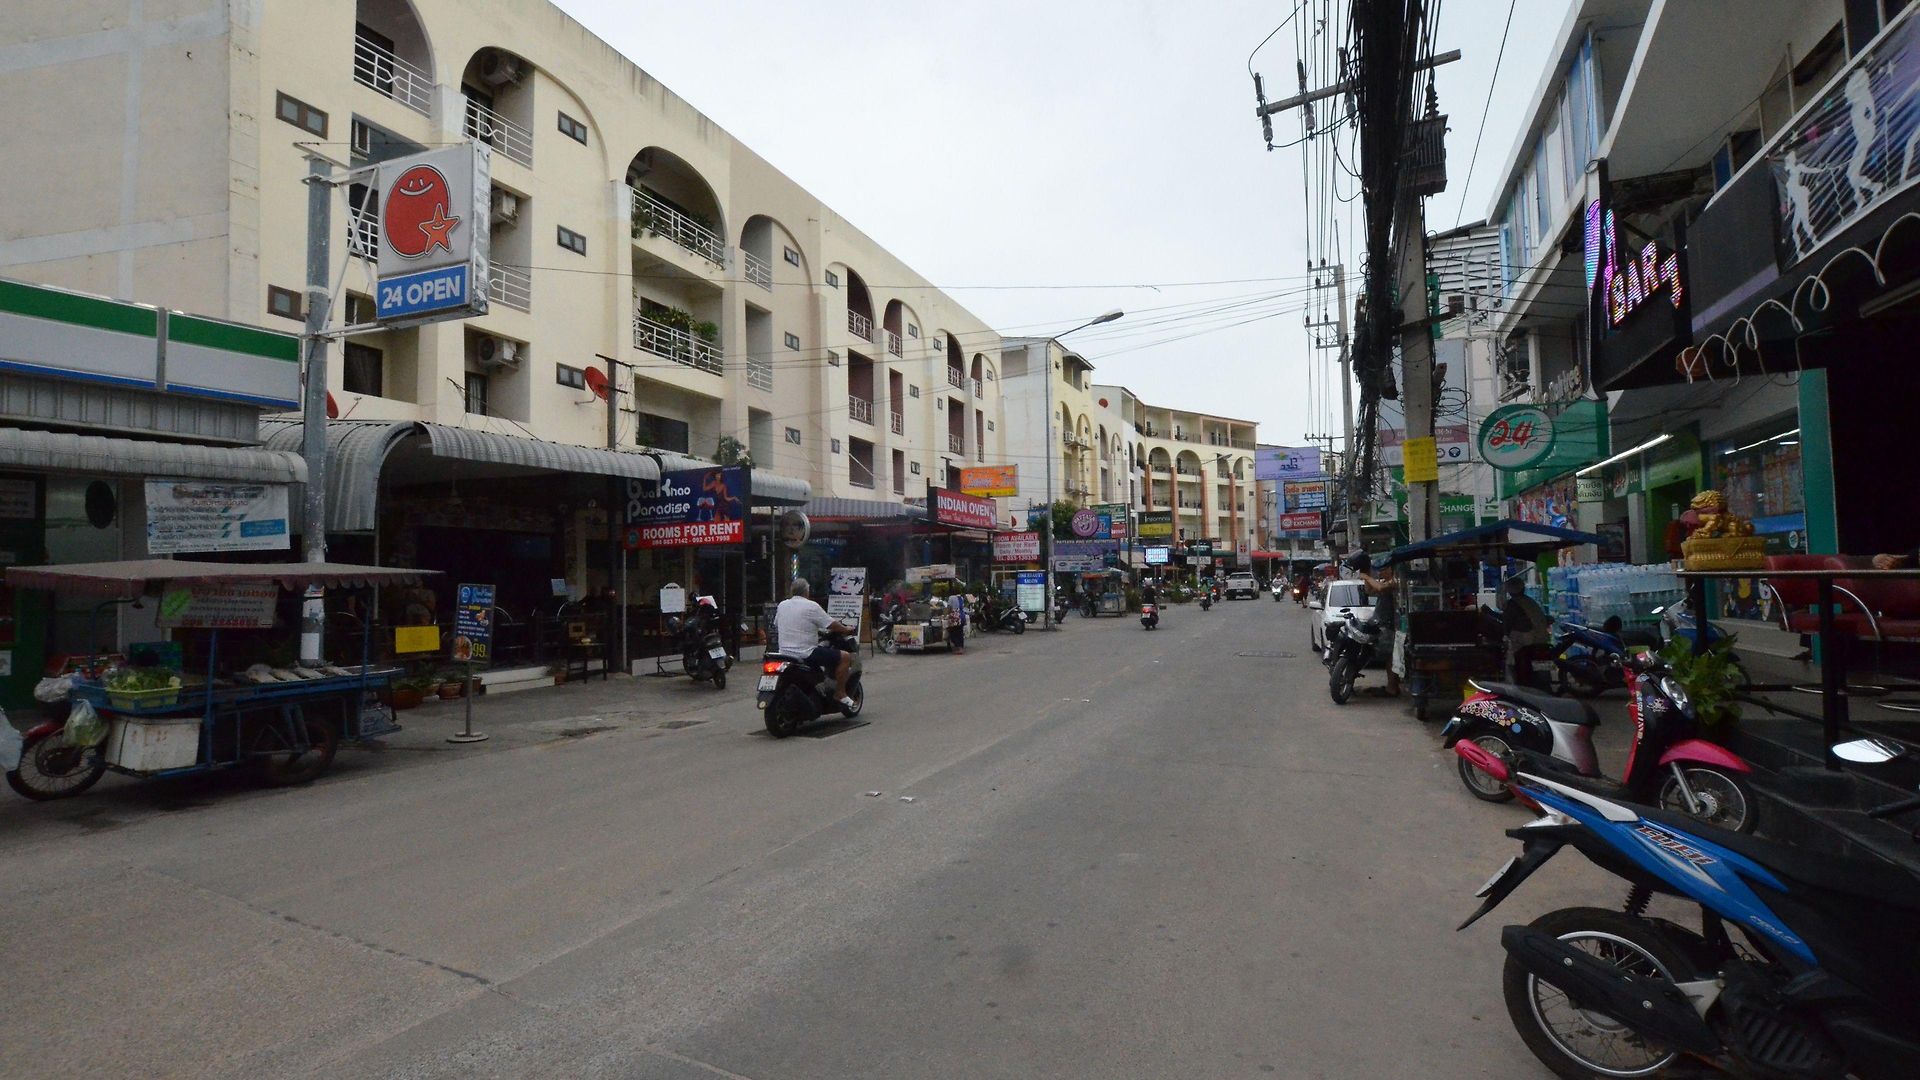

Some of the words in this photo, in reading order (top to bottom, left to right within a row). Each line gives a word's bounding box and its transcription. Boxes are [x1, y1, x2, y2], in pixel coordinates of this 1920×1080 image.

[382, 285, 403, 309] 24
[406, 275, 460, 305] OPEN
[1490, 420, 1533, 447] 24
[937, 495, 968, 513] INDIAN
[969, 502, 990, 517] OVEN
[643, 526, 681, 540] ROOMS
[683, 524, 706, 537] FOR
[709, 521, 741, 536] RENT
